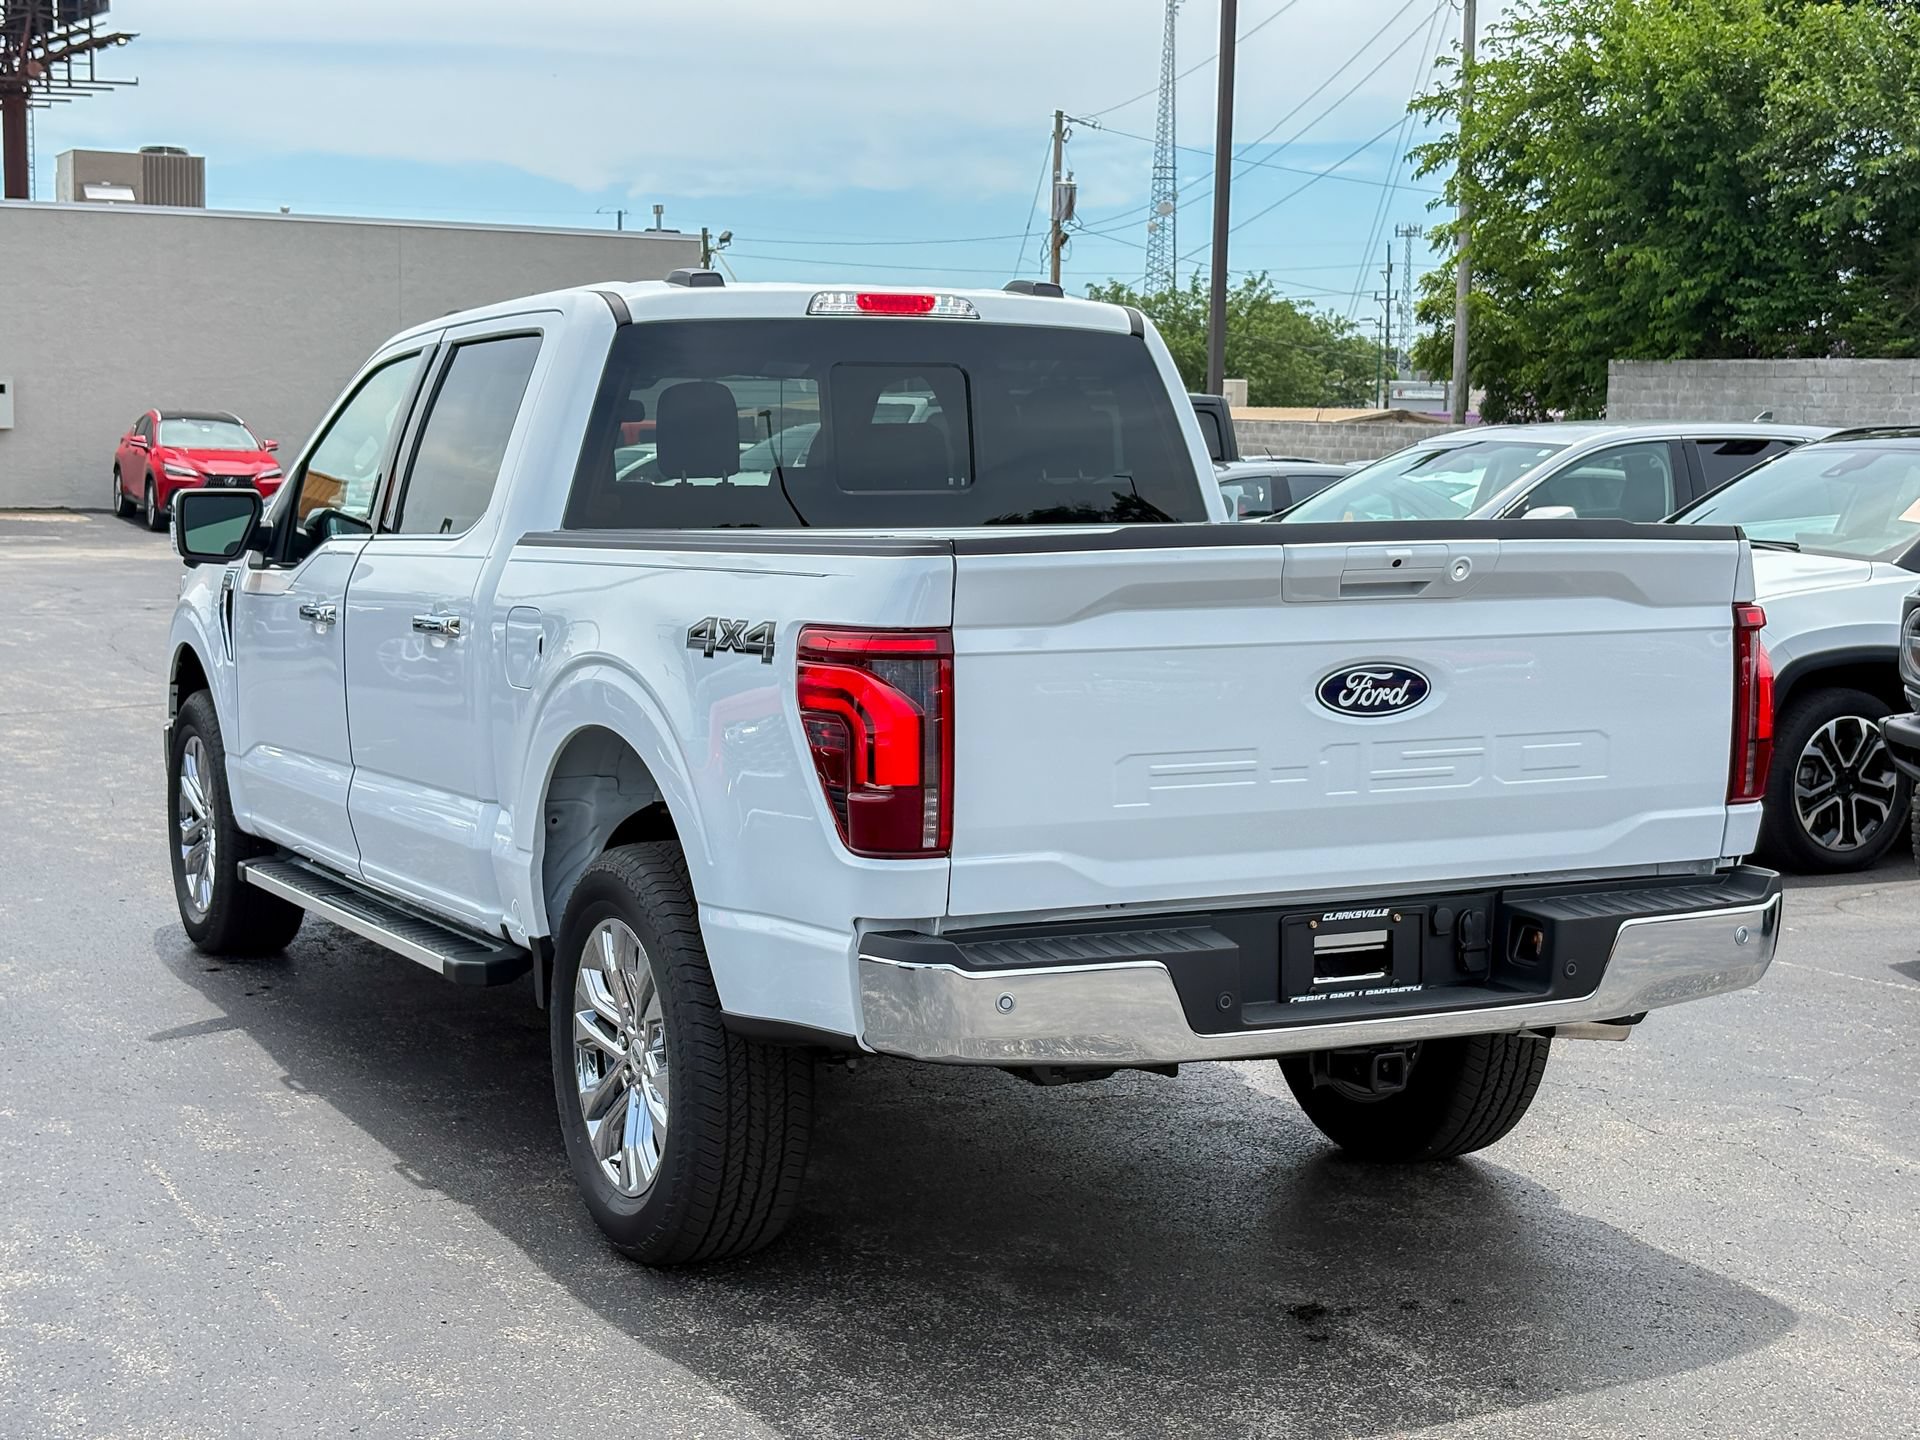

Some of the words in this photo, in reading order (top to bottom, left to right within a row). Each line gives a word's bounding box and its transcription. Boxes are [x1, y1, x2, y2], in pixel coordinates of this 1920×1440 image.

[1338, 671, 1411, 707] Ford
[1114, 729, 1610, 808] F-150
[1322, 908, 1391, 922] CLARKSVILLE
